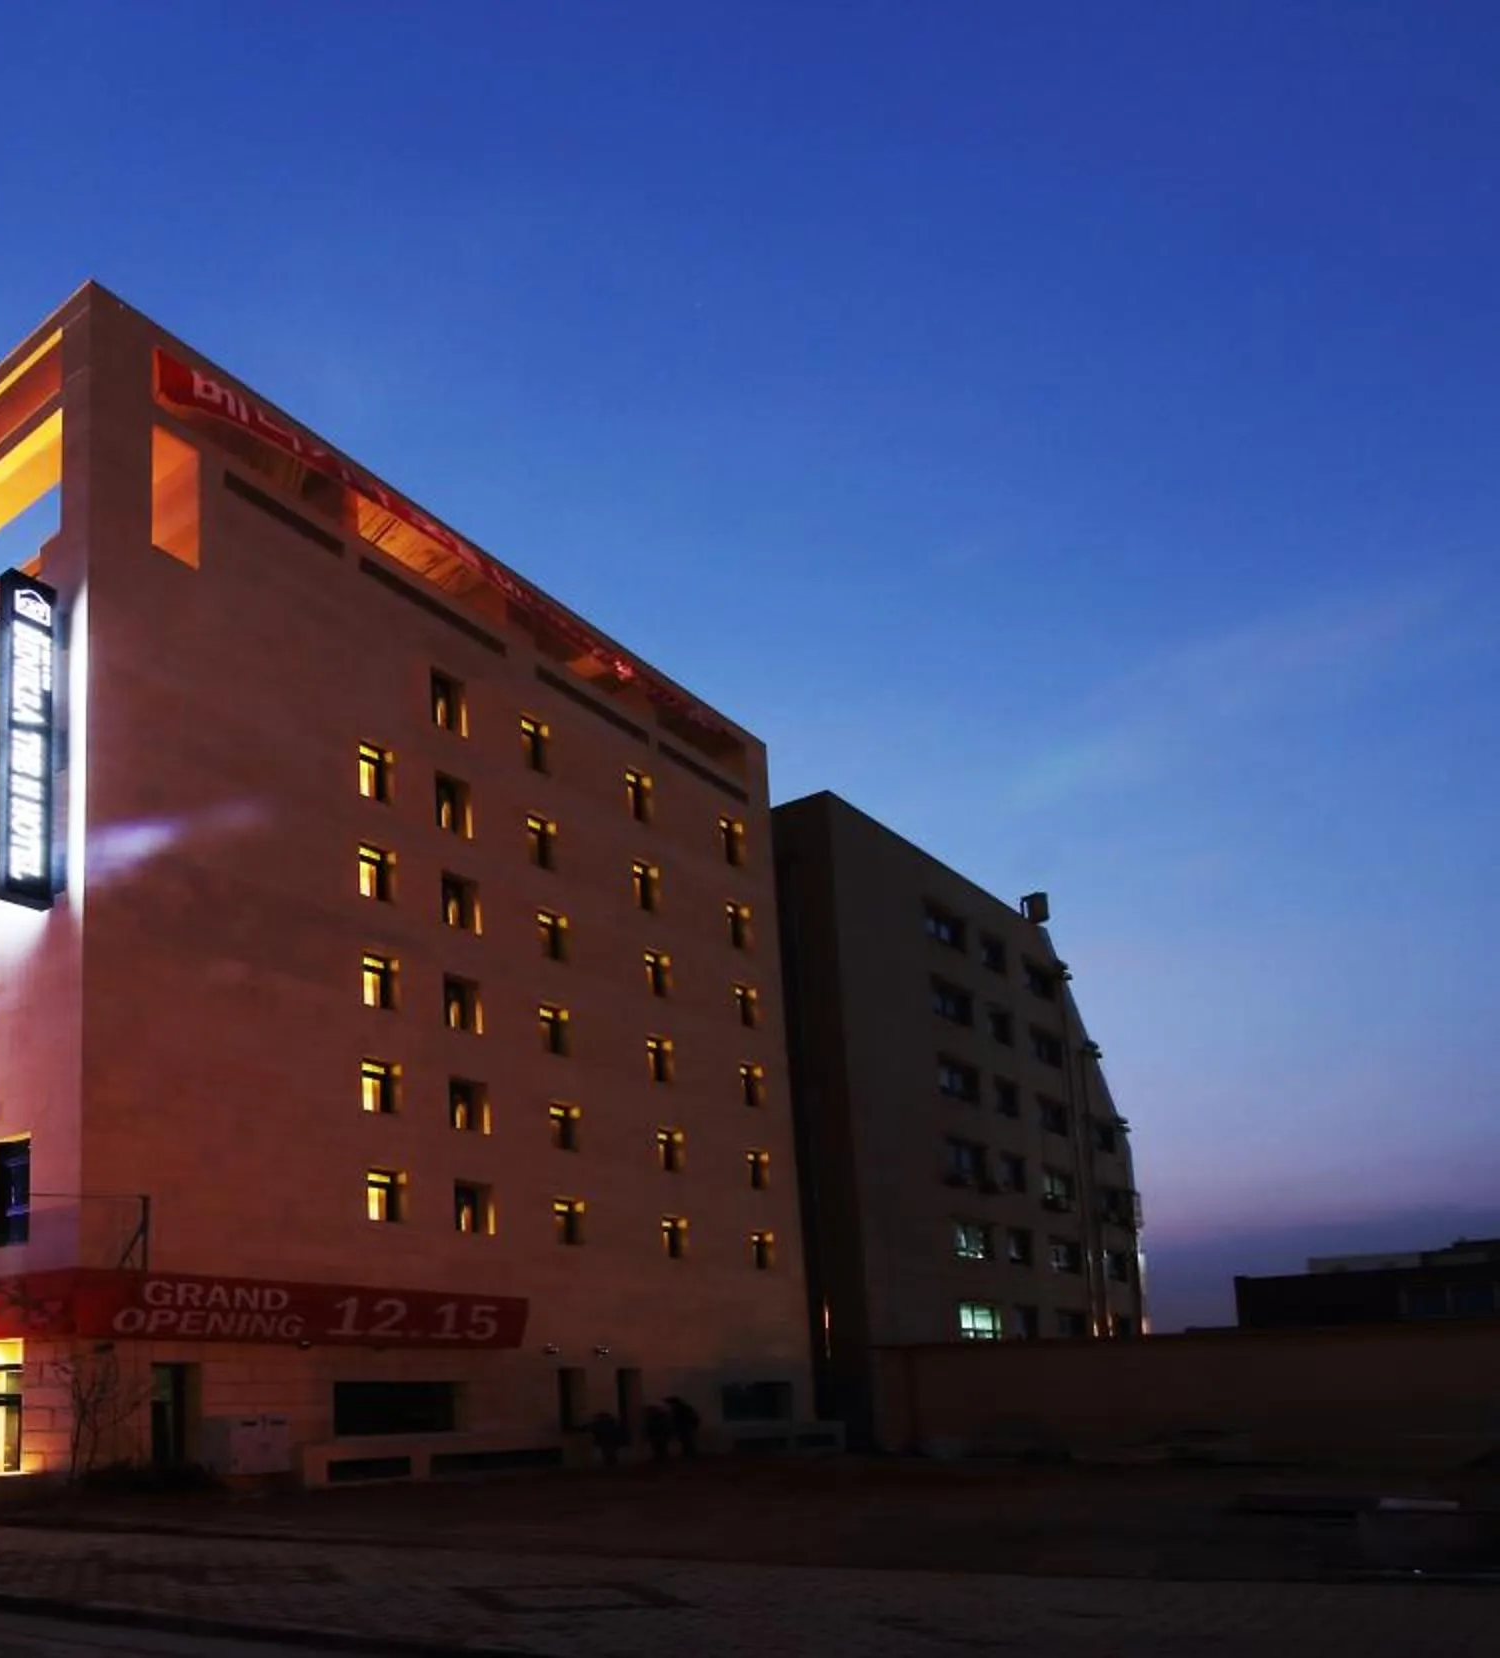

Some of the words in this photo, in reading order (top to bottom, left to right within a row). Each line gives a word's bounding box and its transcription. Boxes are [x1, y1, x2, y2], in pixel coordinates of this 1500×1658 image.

[9, 795, 44, 881] HOTEL
[143, 1280, 289, 1311] GRAND
[112, 1307, 306, 1339] OPENING
[327, 1296, 500, 1341] 12.15
